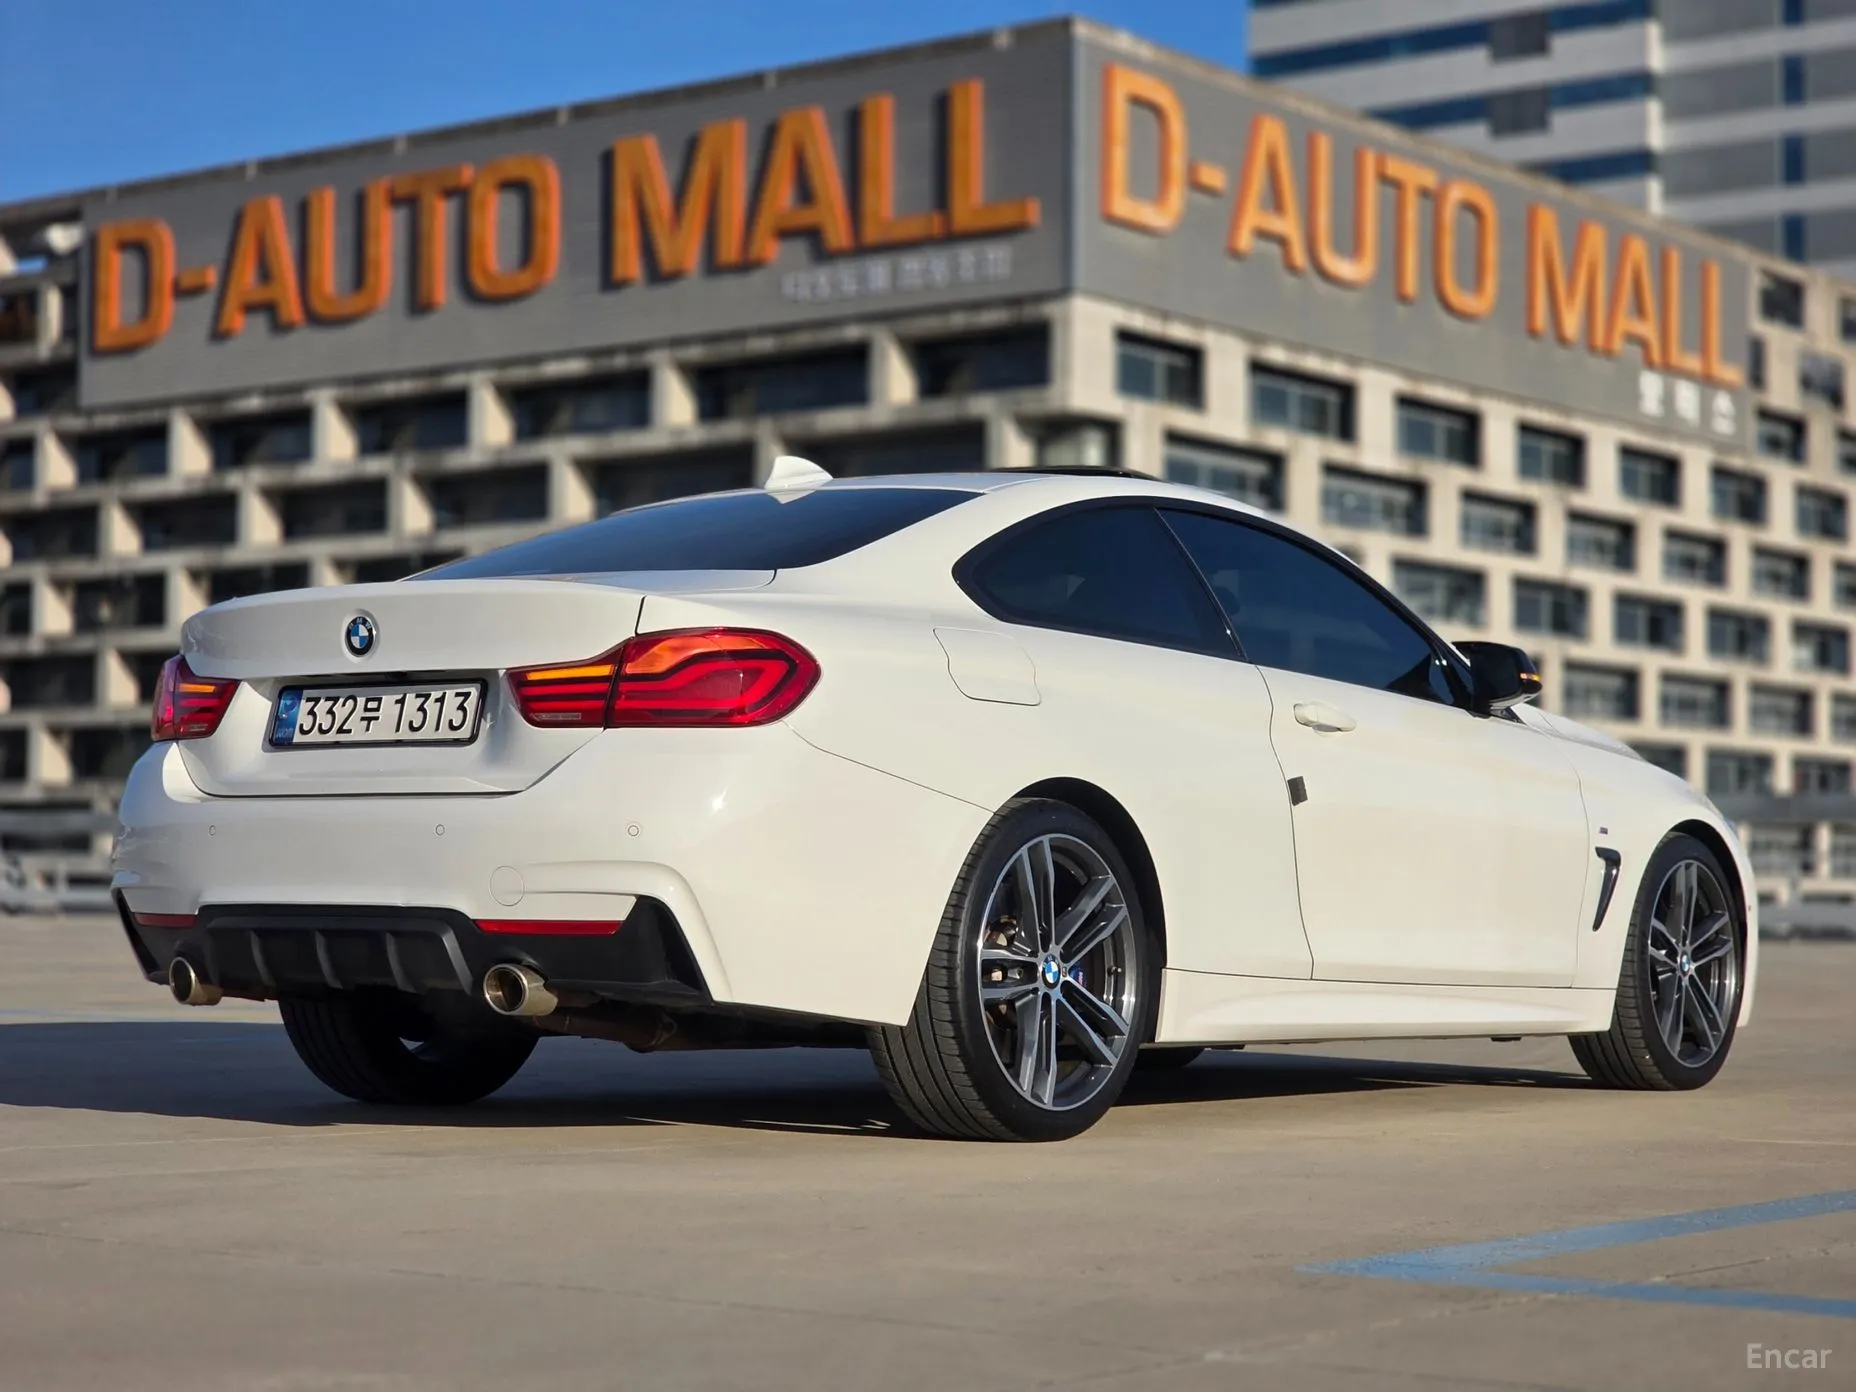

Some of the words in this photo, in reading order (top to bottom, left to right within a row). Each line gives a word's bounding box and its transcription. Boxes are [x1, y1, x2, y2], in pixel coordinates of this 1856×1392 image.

[92, 153, 562, 355] D-AUTO
[610, 76, 1041, 285] MALL
[1101, 62, 1500, 320] D-AUTO
[1525, 203, 1743, 389] MALL
[298, 694, 383, 736] 332무
[394, 691, 472, 734] 1313
